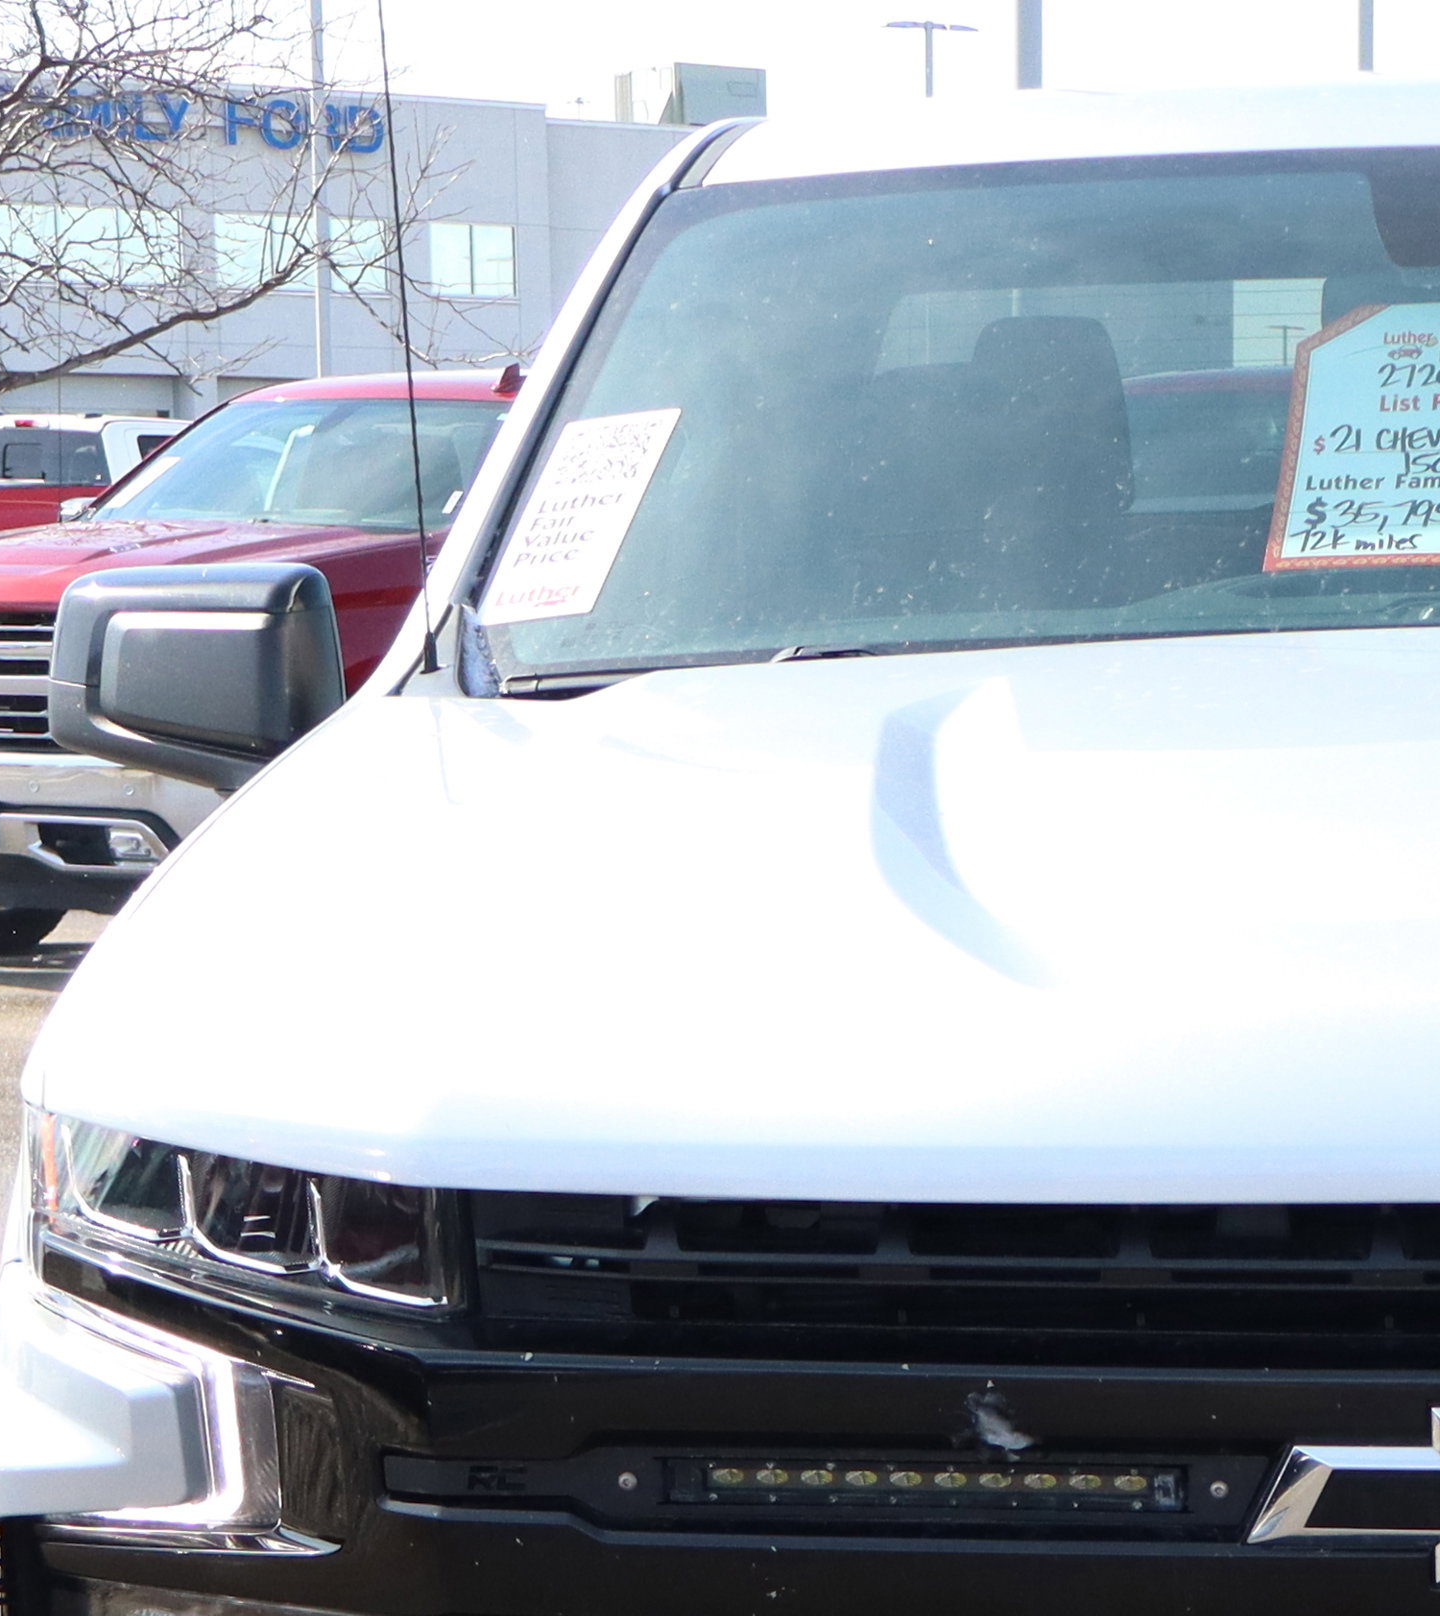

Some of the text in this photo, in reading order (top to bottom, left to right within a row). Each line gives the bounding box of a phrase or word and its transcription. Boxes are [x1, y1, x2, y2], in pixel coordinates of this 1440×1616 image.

[226, 99, 383, 153] FORD
[1383, 330, 1433, 345] Luther
[1380, 394, 1420, 412] List
[1306, 475, 1385, 491] Luther
[537, 493, 622, 514] Luther
[524, 529, 595, 548] Value
[1355, 533, 1422, 551] miles
[513, 549, 580, 567] Price
